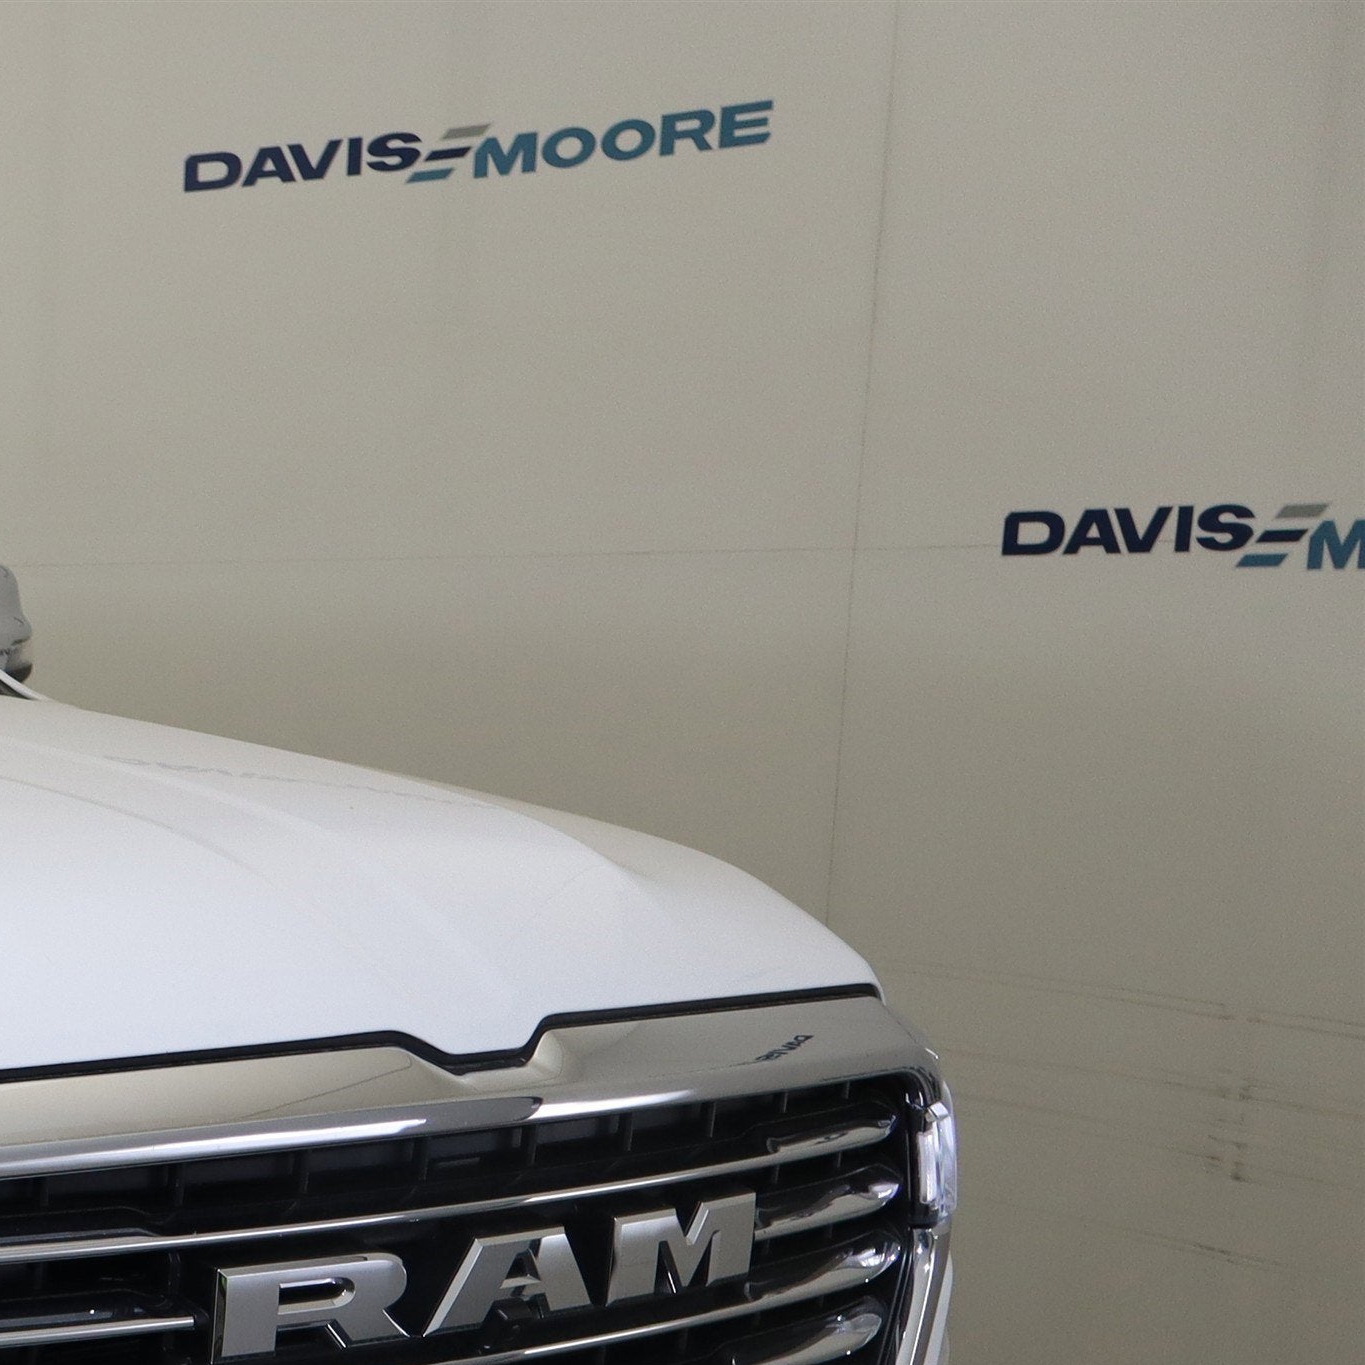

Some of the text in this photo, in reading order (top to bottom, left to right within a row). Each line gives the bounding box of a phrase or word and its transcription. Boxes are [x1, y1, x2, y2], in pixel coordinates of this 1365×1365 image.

[182, 99, 774, 192] DAVIS MOORE
[1001, 503, 1257, 556] DAVIS
[210, 1190, 758, 1364] RAM
